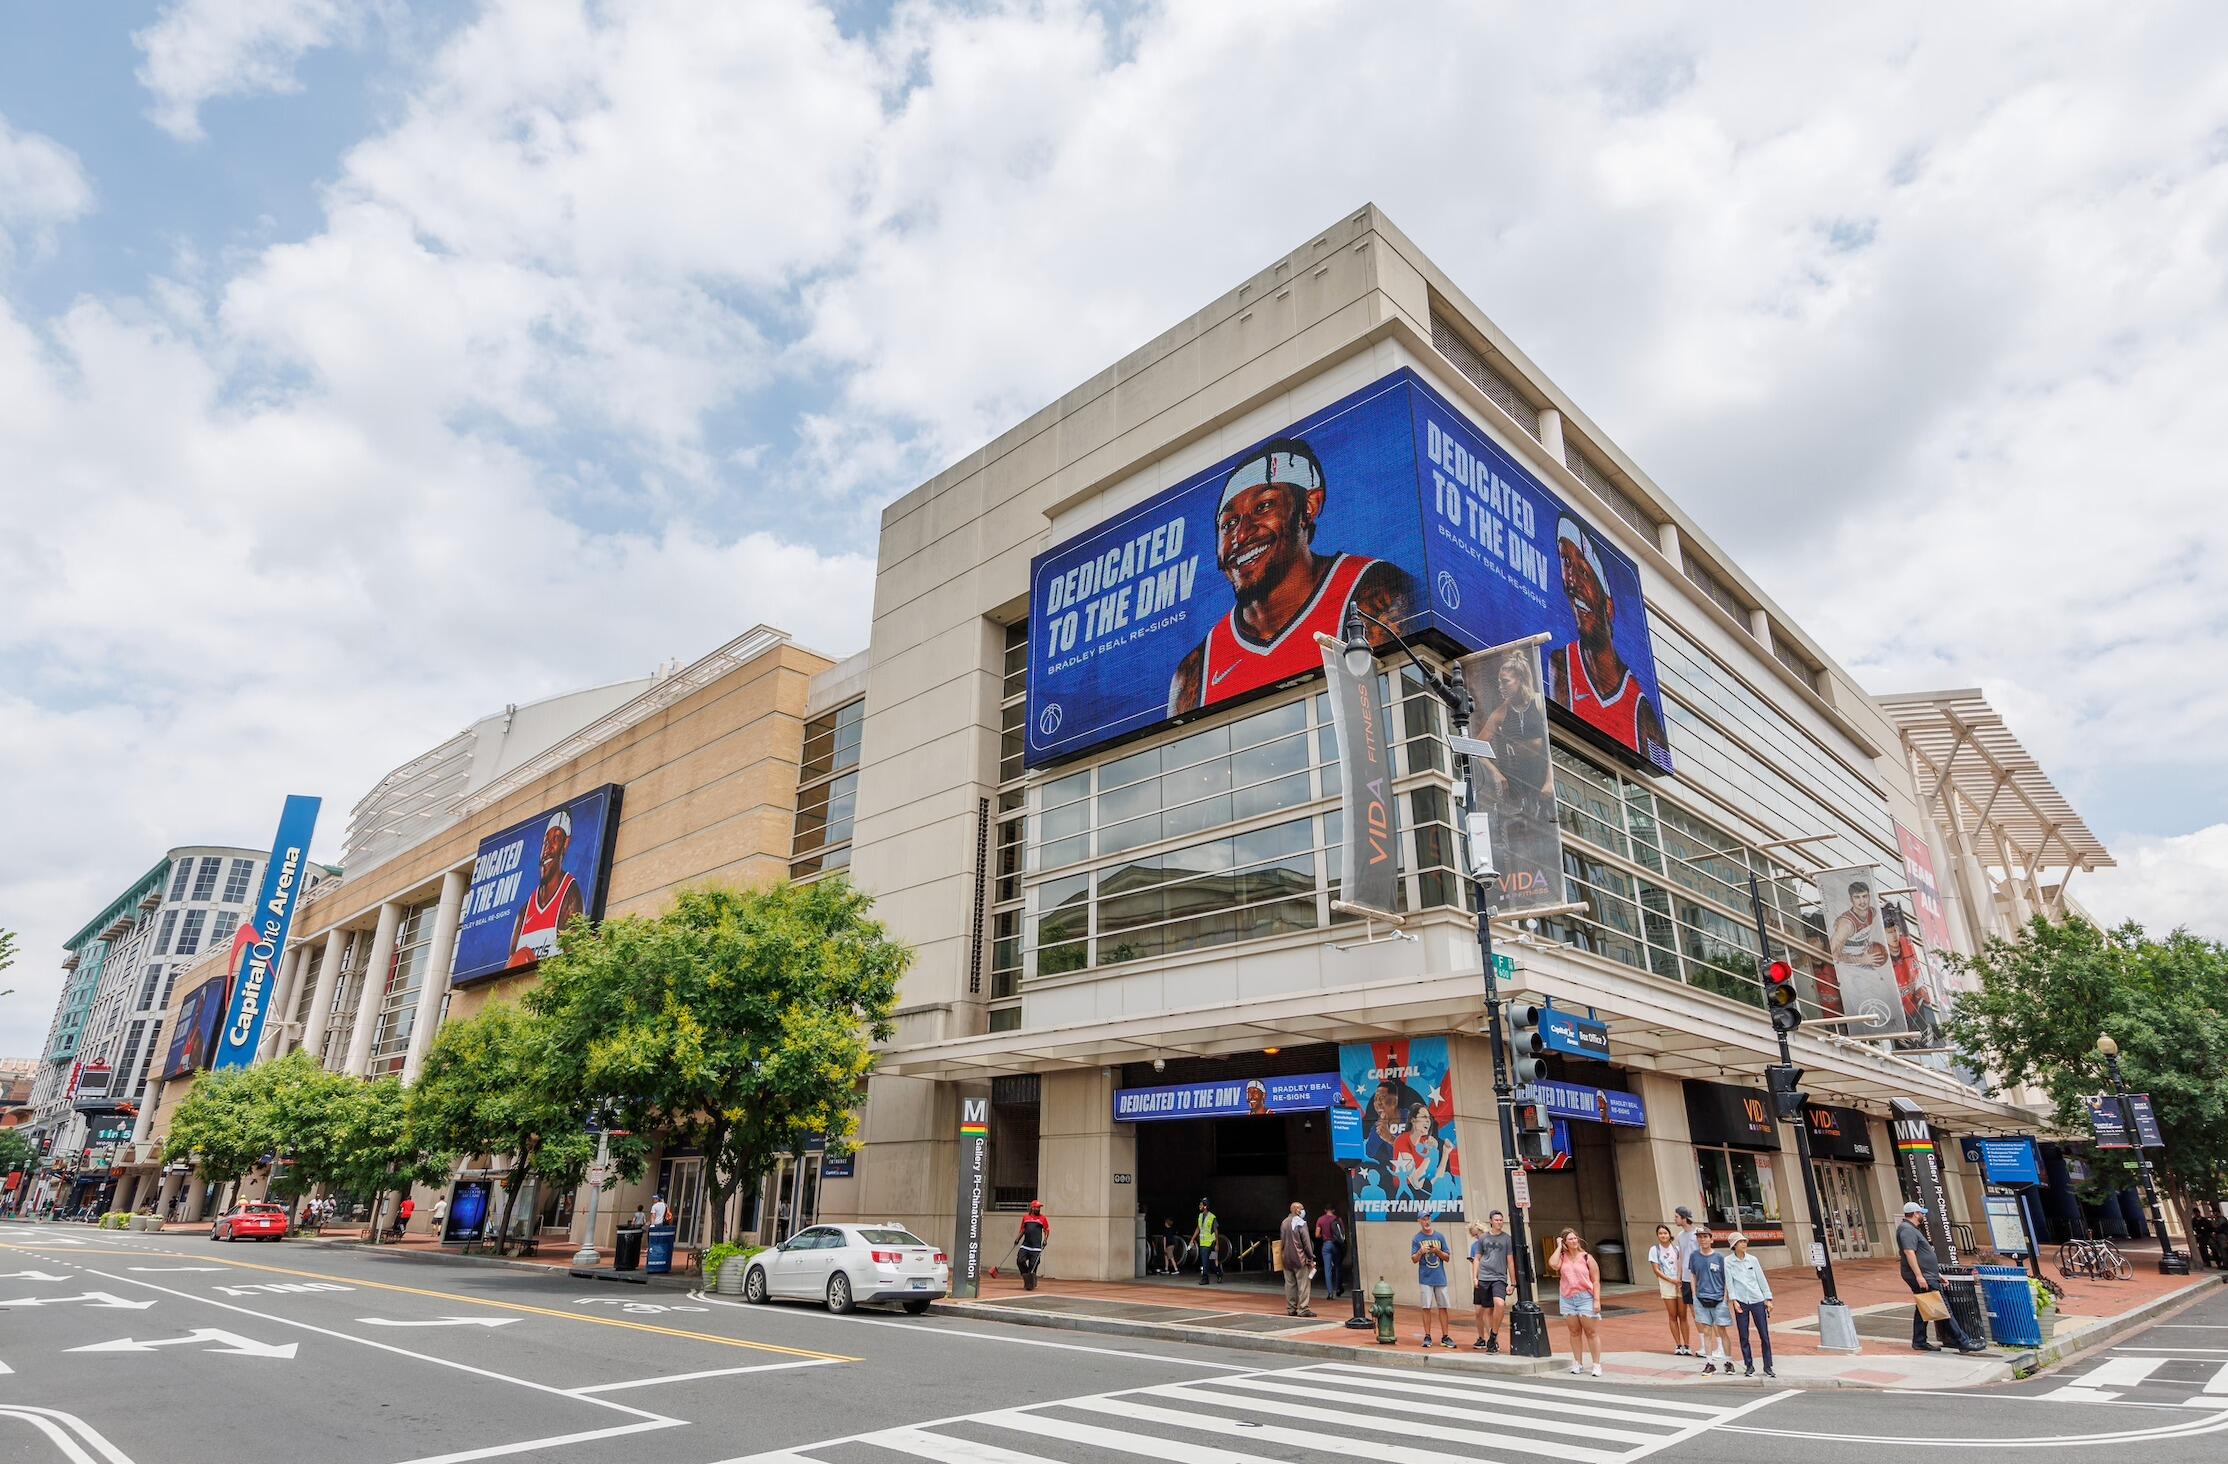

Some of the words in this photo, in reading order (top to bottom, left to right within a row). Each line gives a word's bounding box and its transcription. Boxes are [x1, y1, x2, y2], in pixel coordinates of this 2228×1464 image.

[1428, 419, 1536, 540] DEDICATED
[1432, 469, 1462, 527] TO
[1466, 495, 1505, 561] THE
[1508, 528, 1548, 593] DMV
[1046, 516, 1186, 617] DEDICATED
[1438, 523, 1482, 562] BRADLEY
[1483, 557, 1506, 581] BEAL
[1507, 576, 1548, 609] RE-SIGNS
[1047, 610, 1079, 659] TO
[1085, 585, 1132, 643] THE
[1135, 554, 1199, 621] DMV
[1047, 649, 1096, 675] BRADLEY
[1098, 637, 1128, 654] BEAL
[1129, 610, 1187, 642] RE-SIGNS
[1357, 682, 1378, 764] FITNESS
[1366, 777, 1390, 866] VIDA
[471, 839, 525, 886] EDICATED
[268, 846, 301, 917] Arena
[472, 880, 497, 916] THE
[492, 870, 524, 908] DMV
[1498, 869, 1549, 893] VIDA
[1498, 956, 1504, 967] F
[1579, 1031, 1589, 1041] Box
[1588, 1033, 1603, 1045] Office
[1367, 1066, 1420, 1080] CAPITAL
[1120, 1090, 1176, 1114] DEDICATED
[1177, 1089, 1191, 1110] TO
[1193, 1088, 1214, 1109] THE
[1215, 1087, 1241, 1107] DMV
[1272, 1084, 1309, 1093] BRADLEY
[1310, 1082, 1332, 1091] BEAL
[1273, 1092, 1311, 1102] RE-SIGNS
[1555, 1087, 1566, 1107] TO
[1566, 1088, 1580, 1110] THE
[1580, 1091, 1595, 1112] DMV
[963, 1100, 987, 1122] M
[1809, 1109, 1840, 1129] VIDA
[107, 1129, 118, 1138] in
[122, 1130, 132, 1139] 5
[1389, 1123, 1407, 1135] OF
[1894, 1120, 1910, 1140] M
[1907, 1120, 1930, 1140] M
[972, 1137, 984, 1172] Gallery
[1908, 1153, 1919, 1183] Gallery
[969, 1174, 982, 1239] Pl-Chinatown
[1354, 1199, 1465, 1213] NTERTAINMENT
[1926, 1153, 1938, 1186] Gallery
[1934, 1185, 1952, 1243] Pl-Chinatown
[1948, 1245, 1959, 1266] Stat
[967, 1241, 979, 1279] Station
[211, 1282, 358, 1296] ONLY
